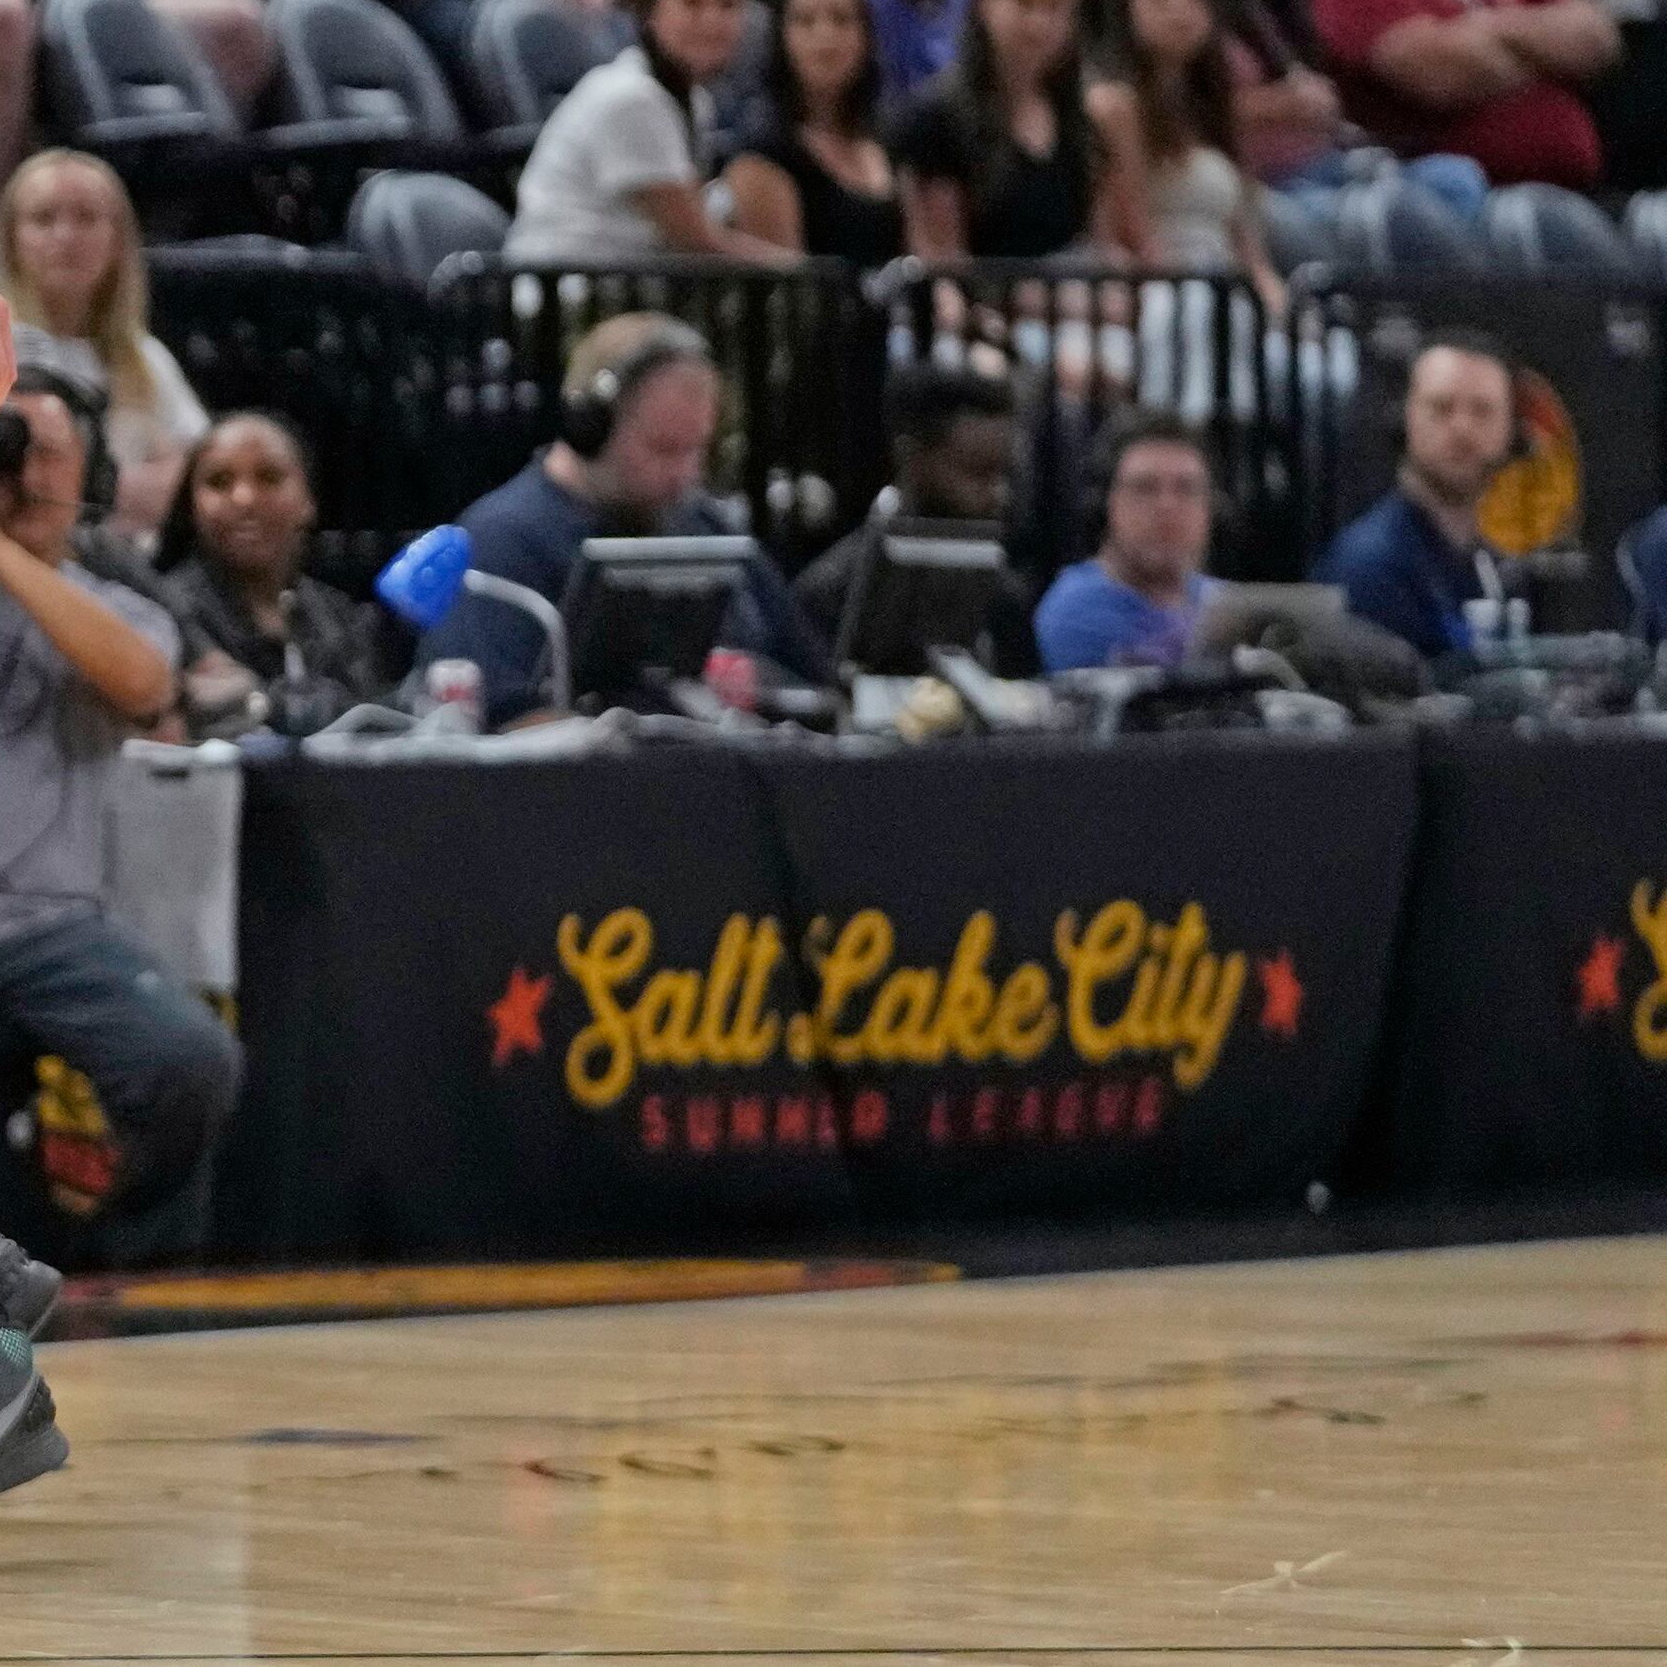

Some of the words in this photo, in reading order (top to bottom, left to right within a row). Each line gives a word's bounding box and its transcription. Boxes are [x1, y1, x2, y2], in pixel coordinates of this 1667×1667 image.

[557, 906, 783, 1109] Salt
[786, 908, 1059, 1065] Lake
[1054, 899, 1247, 1091] City
